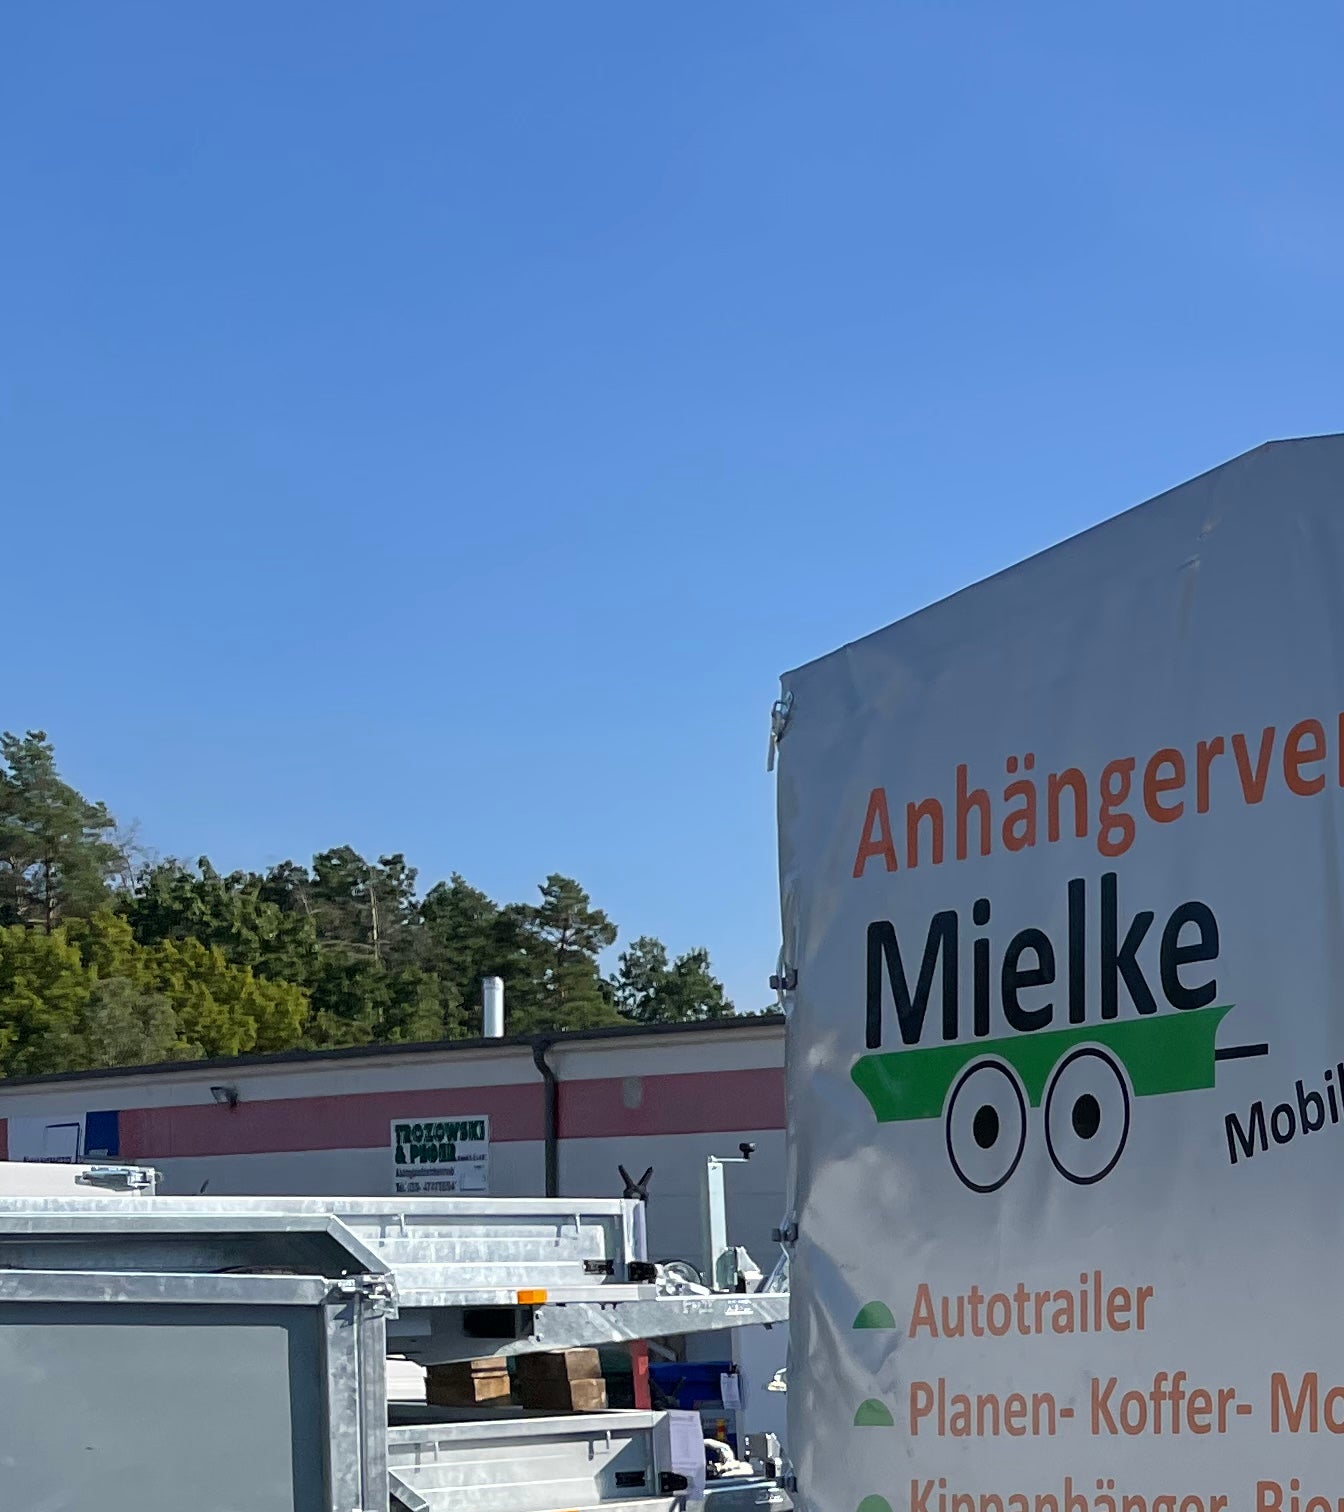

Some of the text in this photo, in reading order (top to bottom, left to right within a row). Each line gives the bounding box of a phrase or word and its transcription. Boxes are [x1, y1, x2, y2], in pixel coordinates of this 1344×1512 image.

[865, 871, 1220, 1049] Mielke
[908, 1270, 1154, 1339] Autotrailer
[908, 1379, 1075, 1437] Planen-
[1089, 1370, 1252, 1436] Koffer-
